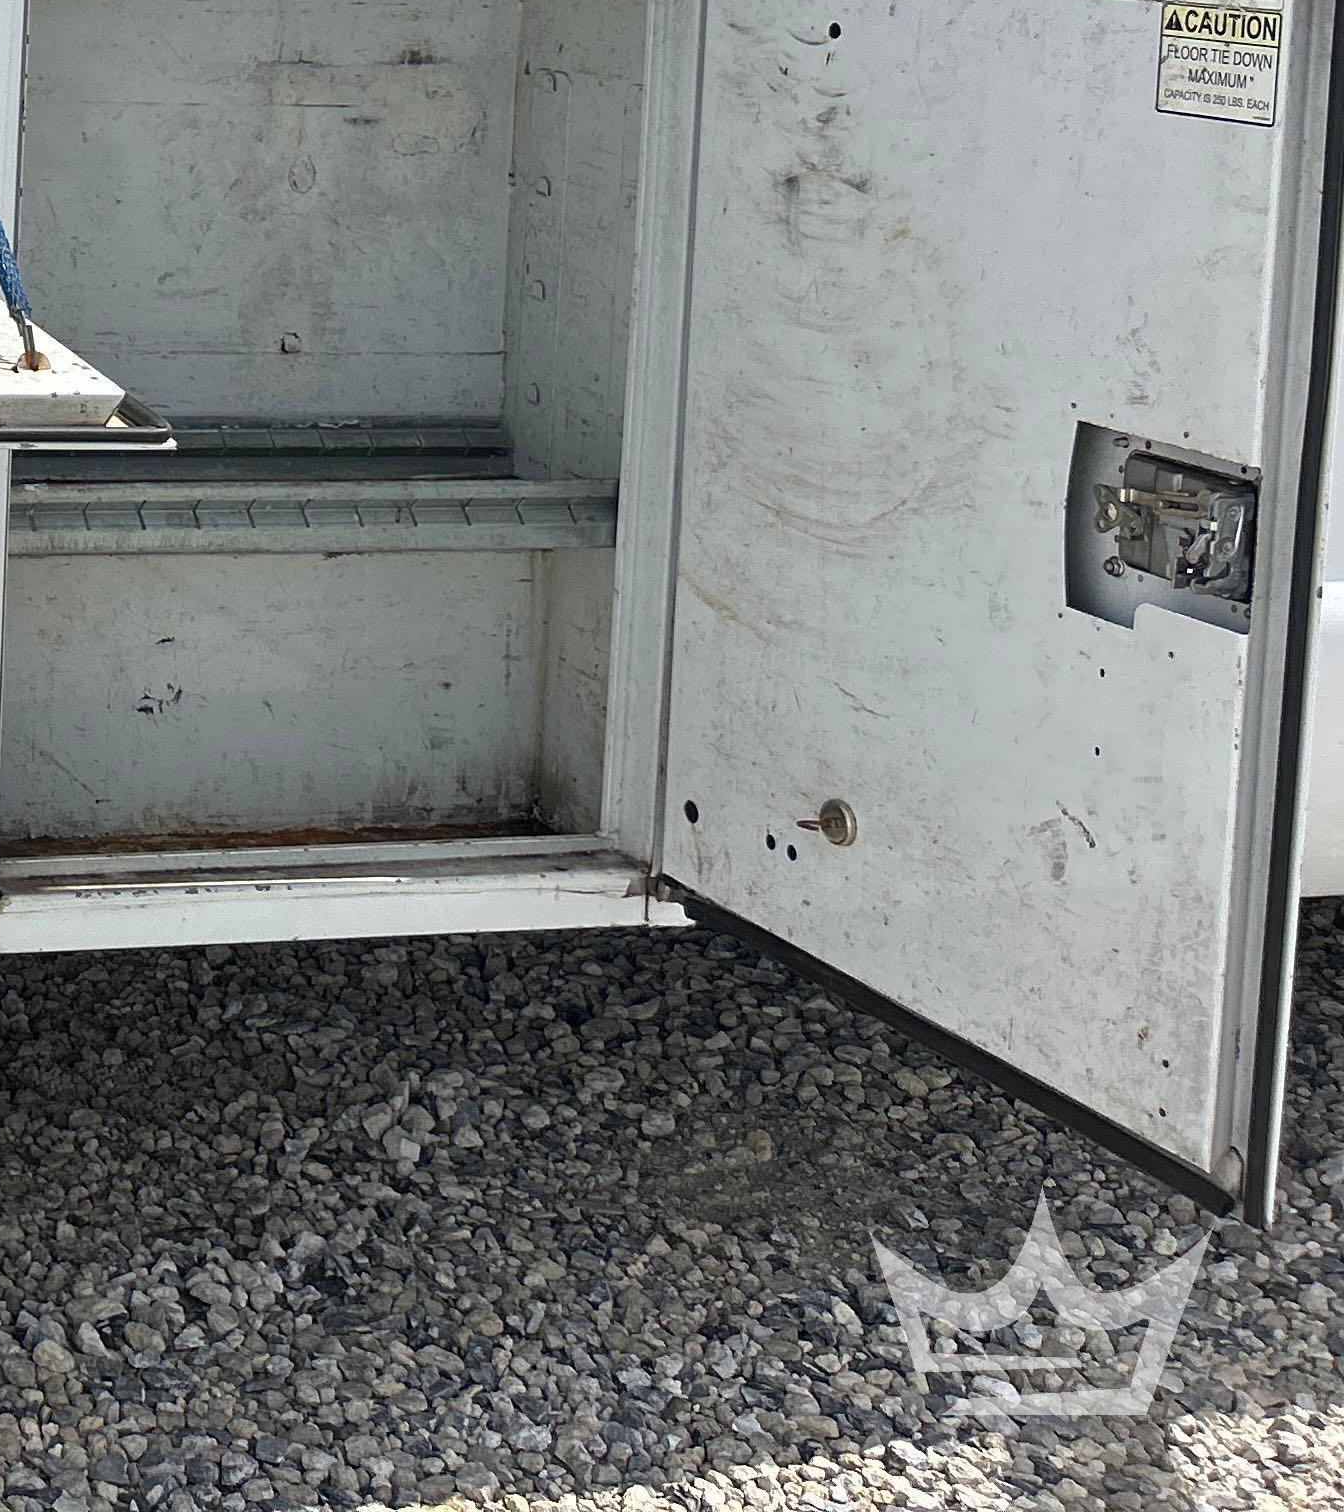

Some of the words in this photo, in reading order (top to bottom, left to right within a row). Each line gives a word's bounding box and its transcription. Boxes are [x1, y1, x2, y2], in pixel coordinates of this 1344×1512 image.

[1185, 9, 1277, 41] CAUTION
[1167, 43, 1208, 62] FLOOR
[1211, 48, 1230, 65] TIE
[1233, 51, 1273, 70] DOWN
[1188, 68, 1247, 88] MAXIMUM
[1164, 88, 1202, 103] CAPACITY
[1203, 93, 1211, 103] IS
[1246, 98, 1270, 111] EACH
